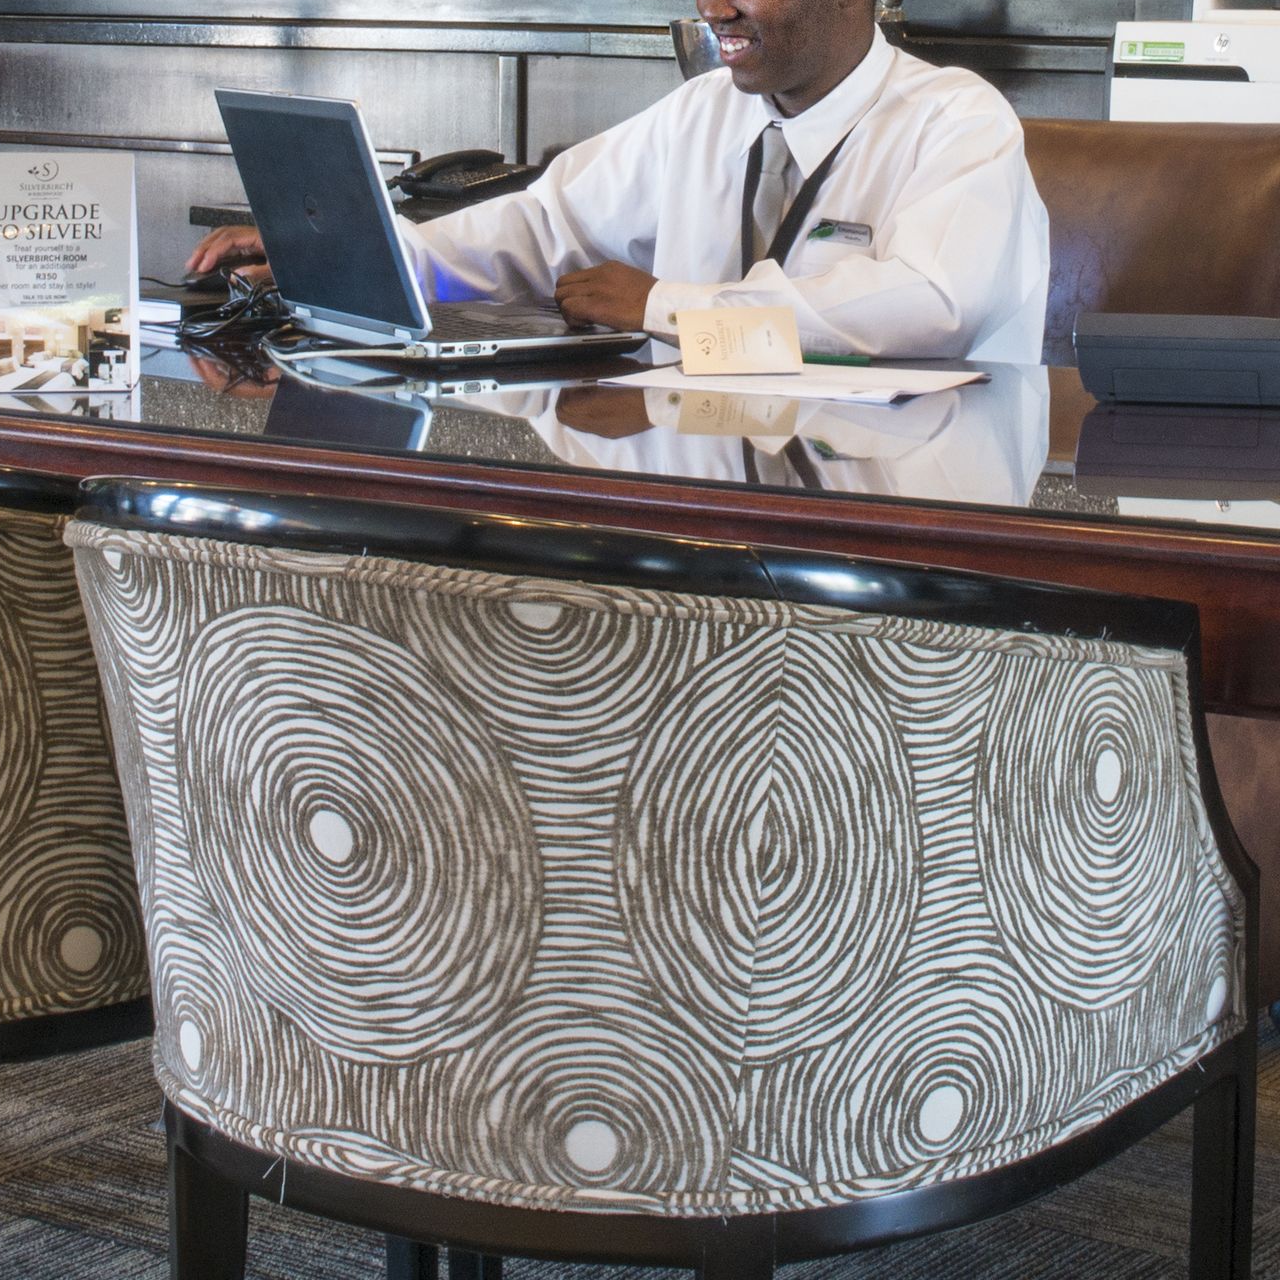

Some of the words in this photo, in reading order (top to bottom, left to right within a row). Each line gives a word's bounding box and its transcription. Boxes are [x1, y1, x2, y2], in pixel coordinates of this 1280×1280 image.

[1215, 32, 1230, 52] hp
[19, 182, 74, 191] SILVERBIRCH
[25, 223, 103, 240] SILVER!
[14, 244, 32, 252] Treat
[34, 244, 64, 253] yourself
[66, 244, 74, 252] to
[6, 255, 61, 263] SILVERBIRCH
[62, 254, 87, 262] ROOM
[15, 262, 26, 270] for
[40, 262, 78, 270] additional
[48, 282, 64, 291] stay
